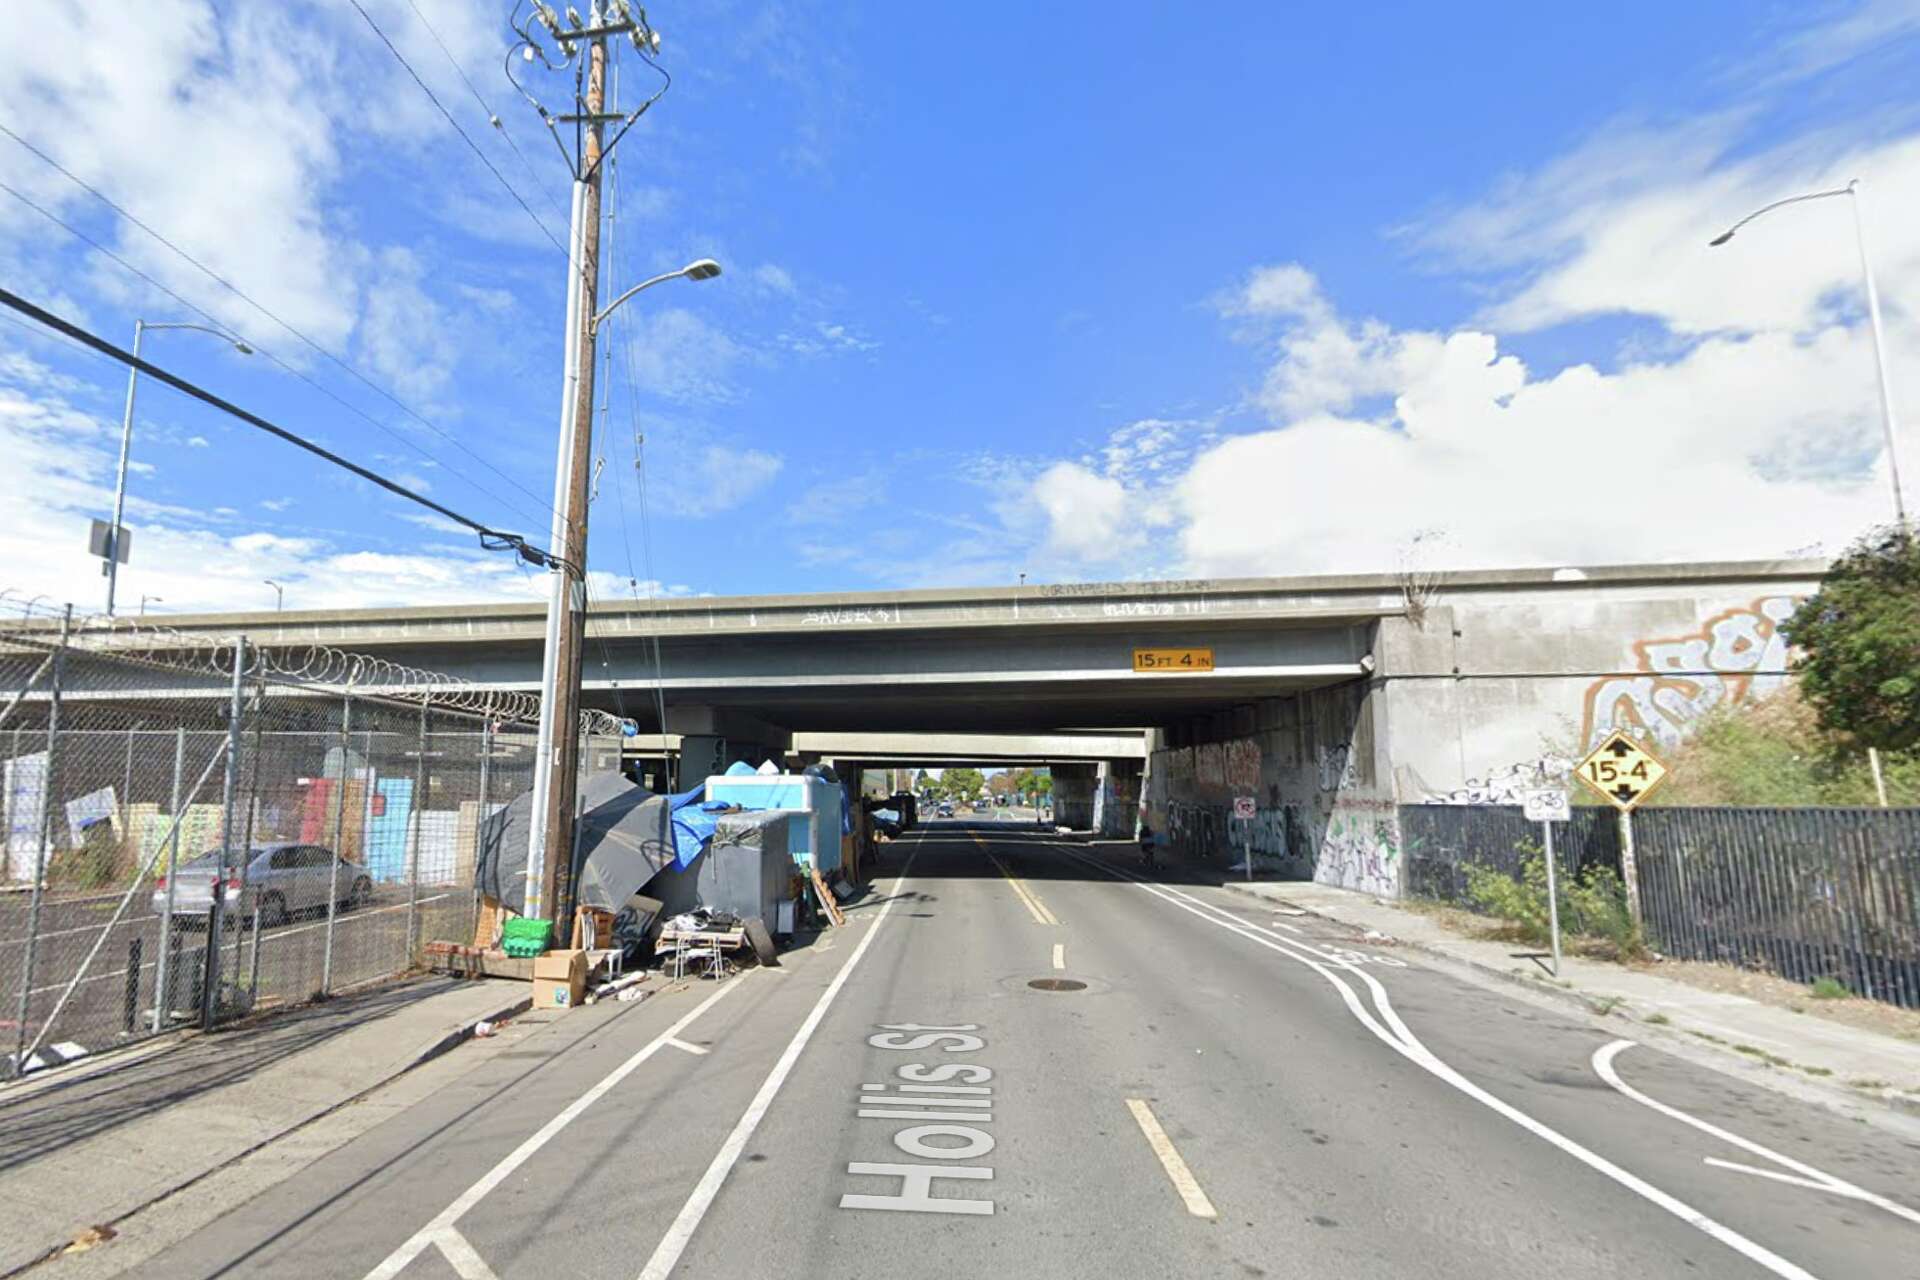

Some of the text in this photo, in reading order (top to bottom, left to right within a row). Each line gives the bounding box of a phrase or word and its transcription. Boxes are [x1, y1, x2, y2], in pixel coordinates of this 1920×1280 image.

[1137, 653, 1210, 667] 15 FT 4 IN
